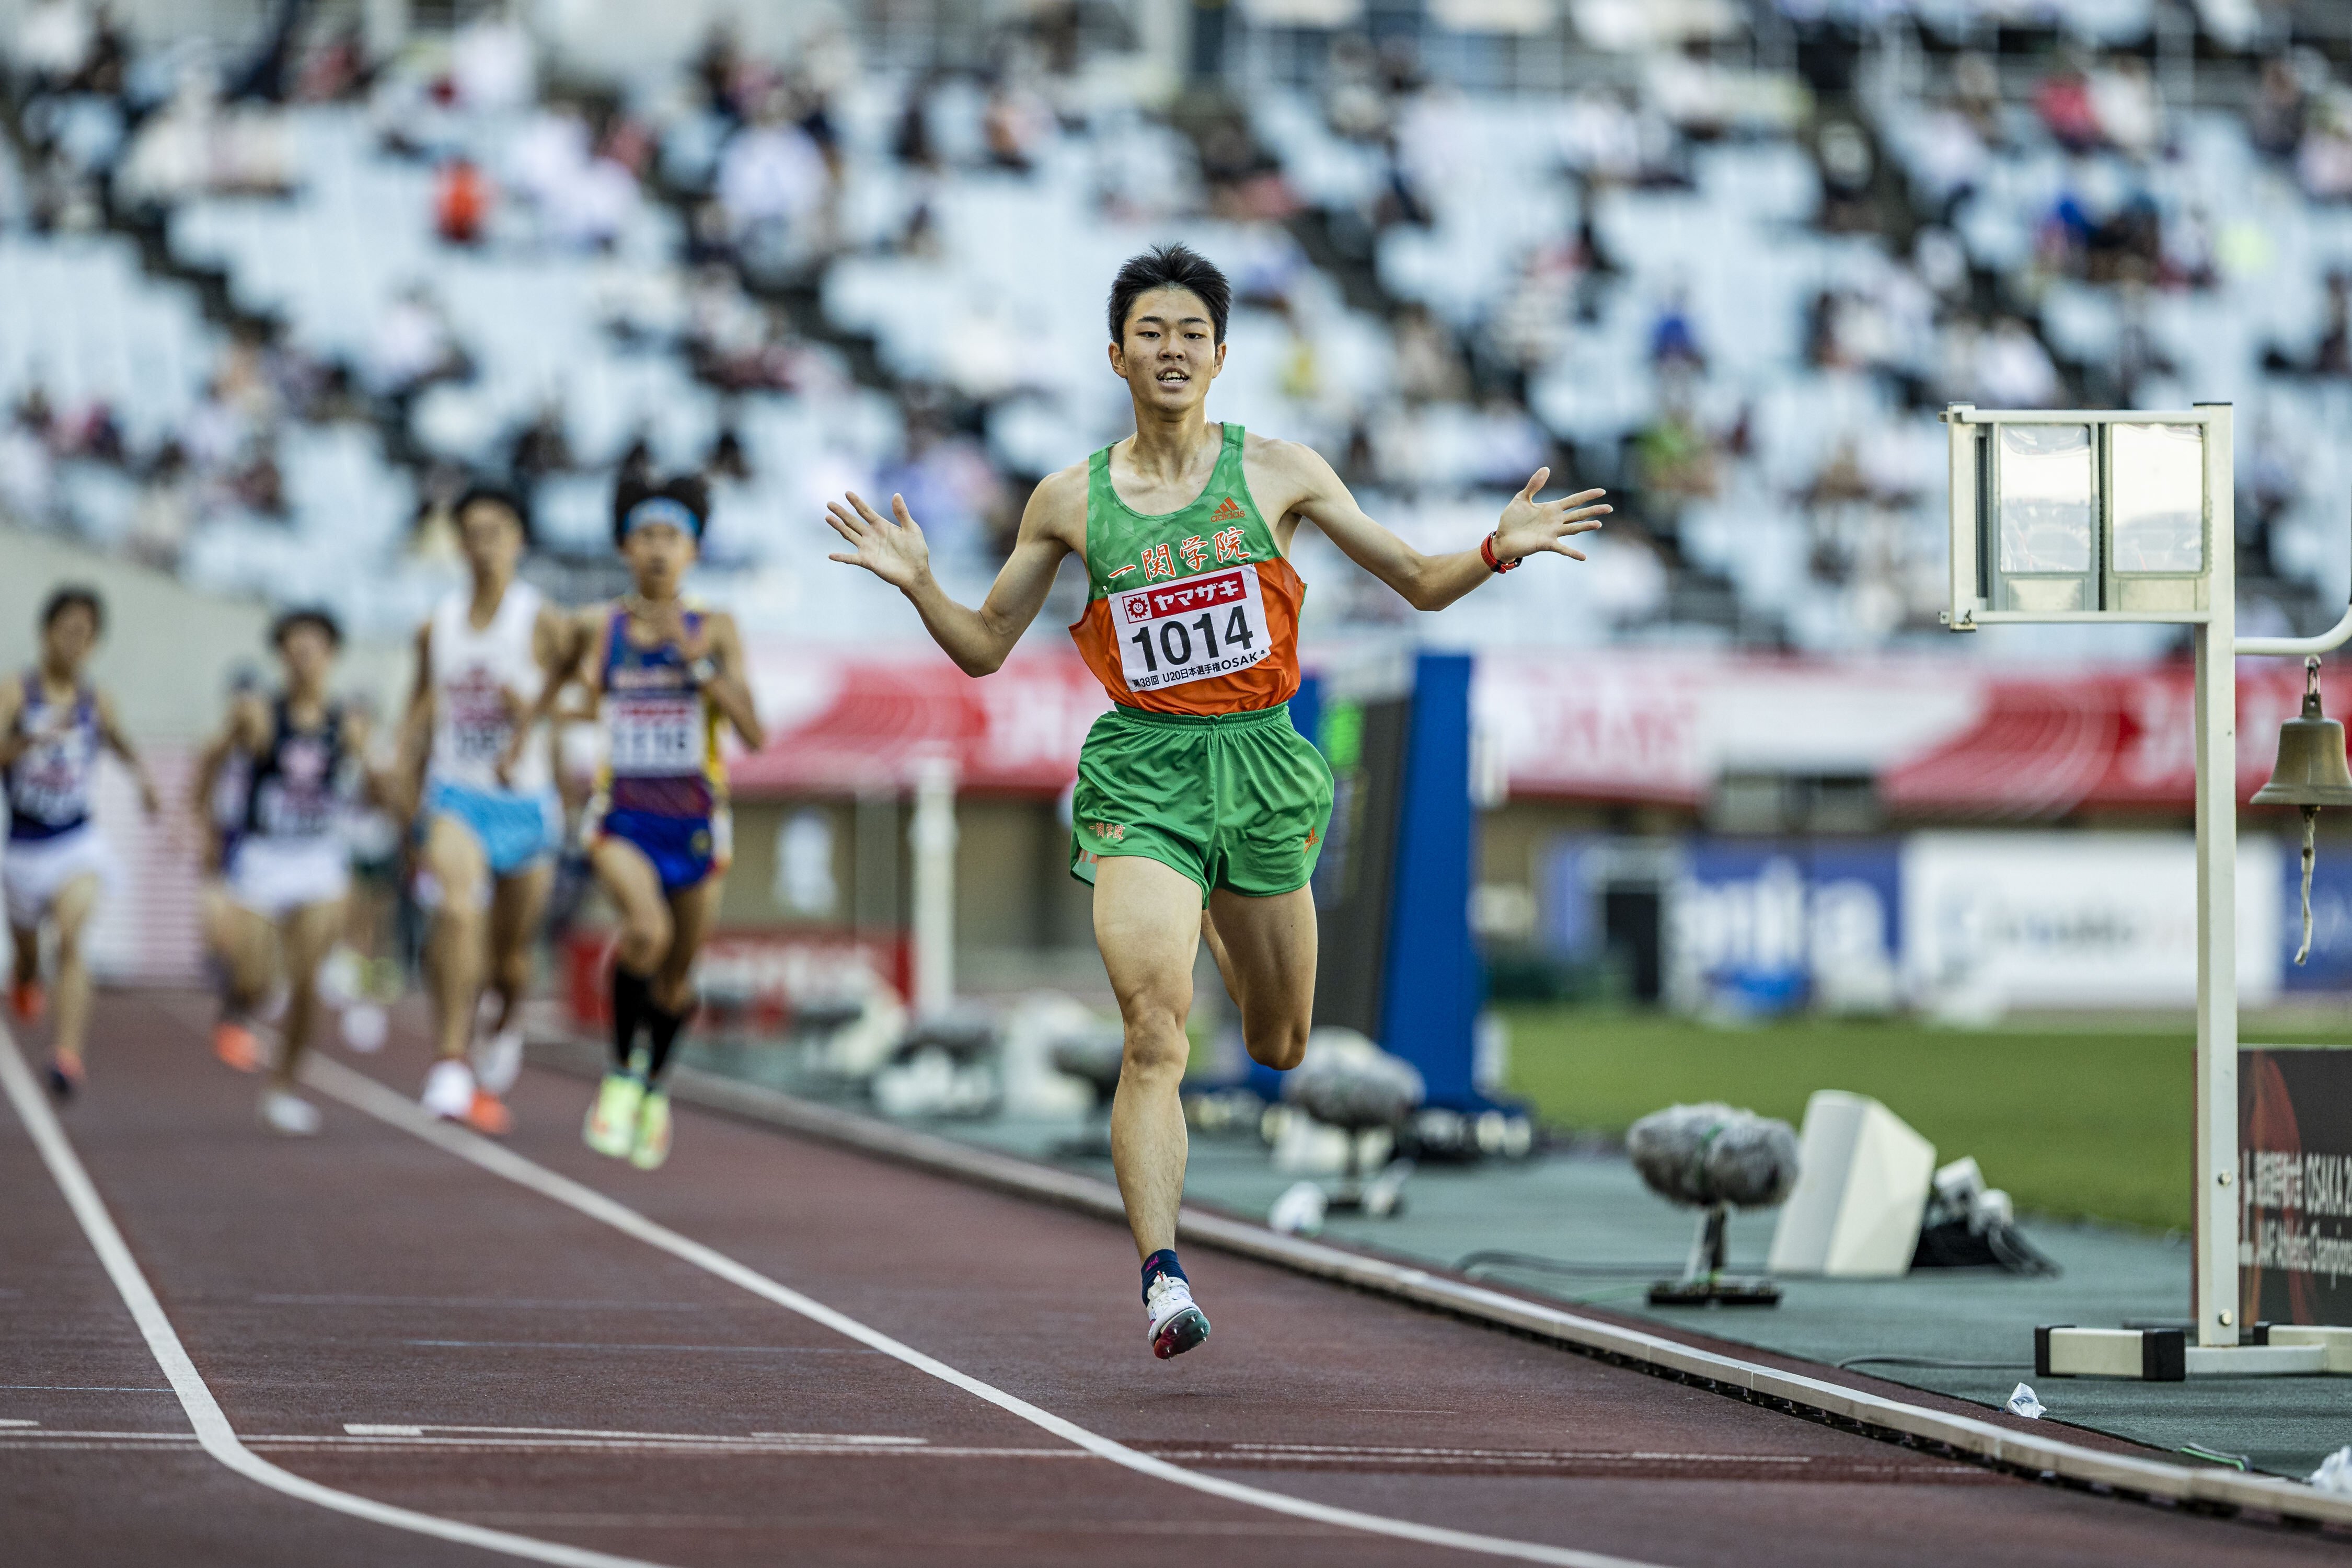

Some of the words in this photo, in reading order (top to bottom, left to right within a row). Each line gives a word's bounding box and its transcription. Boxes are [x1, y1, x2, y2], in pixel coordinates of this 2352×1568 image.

[1210, 510, 1246, 522] adidas
[1108, 526, 1251, 581] 一関学院
[1154, 580, 1239, 611] ヤマザキ
[1132, 605, 1253, 672] 1014
[1132, 675, 1159, 688] 第38回
